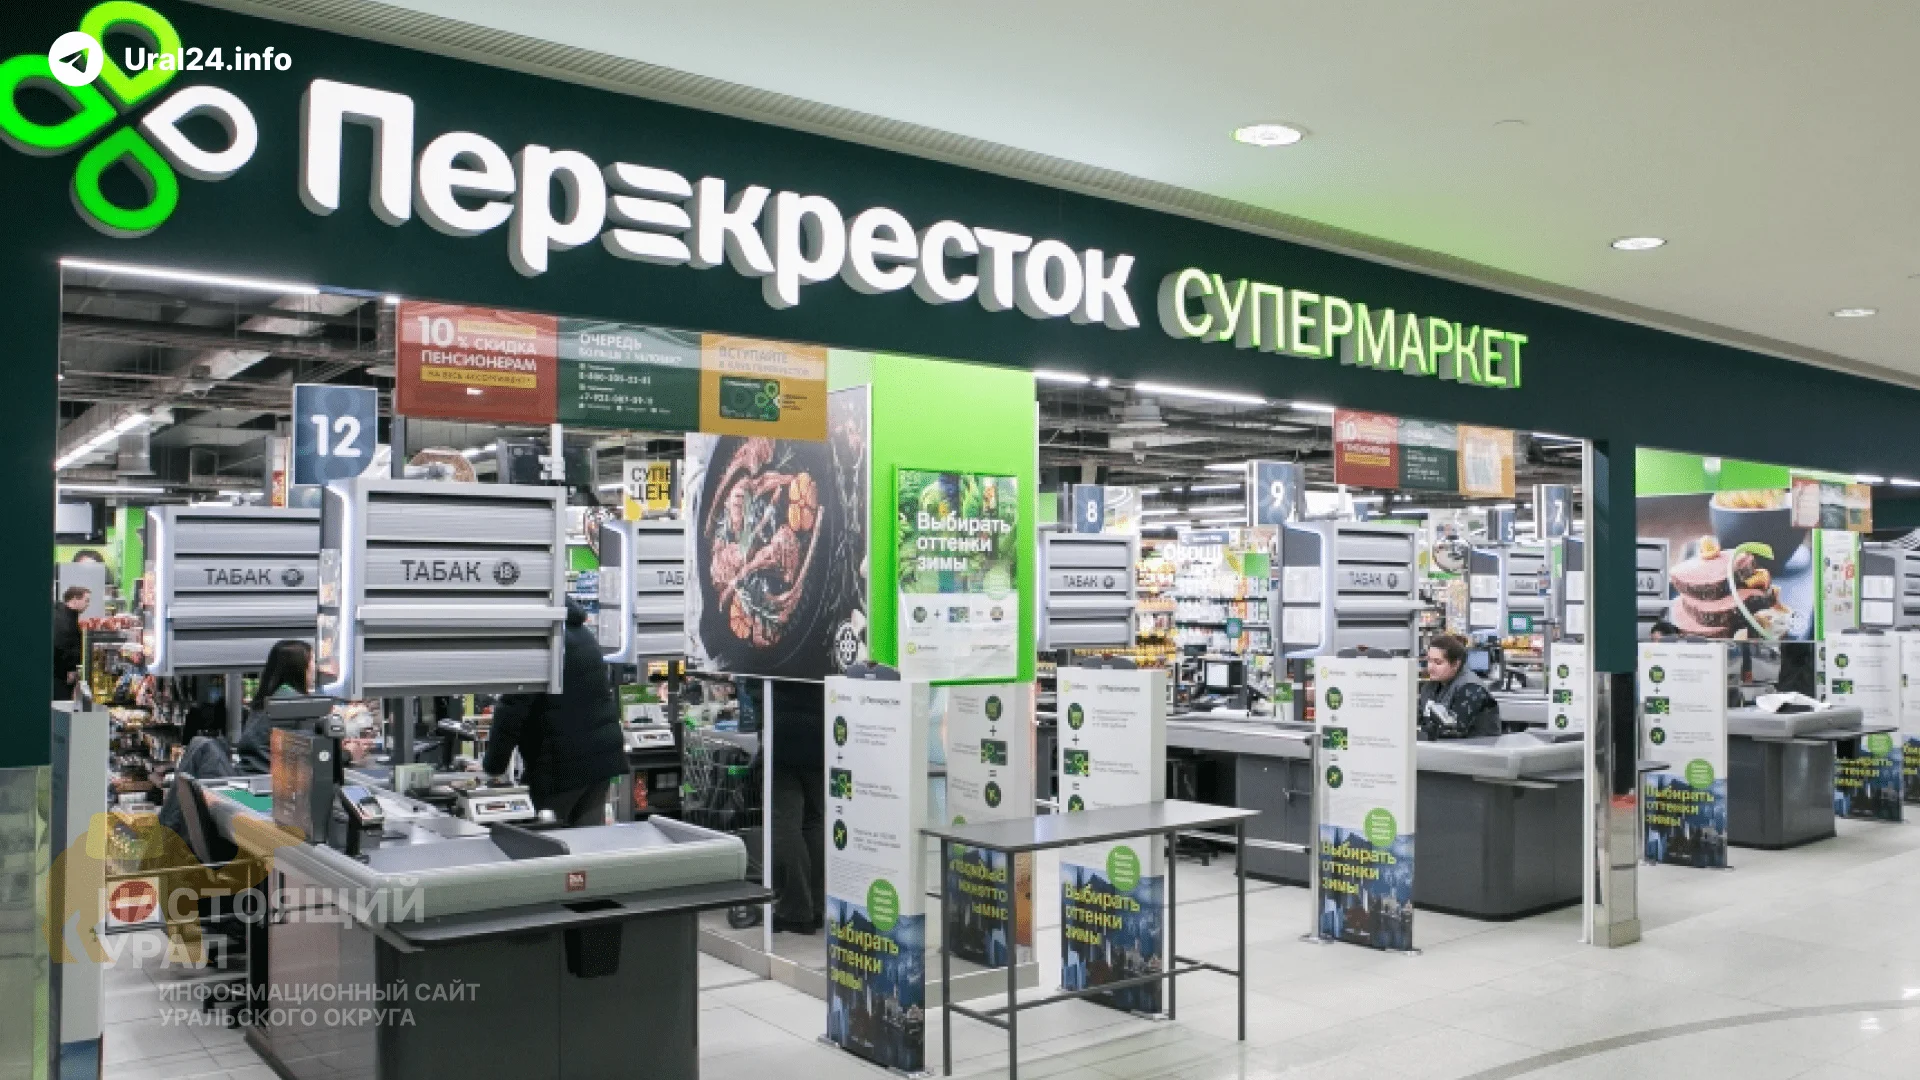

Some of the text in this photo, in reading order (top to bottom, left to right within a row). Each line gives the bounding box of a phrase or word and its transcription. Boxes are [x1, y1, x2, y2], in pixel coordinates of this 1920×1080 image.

[304, 79, 1140, 329] Перекресток
[418, 316, 454, 347] 10
[475, 338, 537, 355] СКИДКА
[1166, 267, 1528, 388] СУПЕРМАРКЕТ
[580, 333, 642, 350] ОЧЕРЕДЬ
[421, 349, 537, 371] ПЕНСИОНЕРАМ
[310, 414, 362, 458] 12
[1271, 481, 1284, 507] 9
[917, 509, 1012, 535] Выбирать
[1087, 501, 1098, 522] 8
[1554, 500, 1563, 522] 7
[917, 537, 993, 552] оттенки
[400, 559, 482, 582] ТАБАК
[917, 555, 968, 571] зимы
[203, 568, 272, 586] ТАБАК
[1322, 840, 1396, 865] Выбирать
[1322, 861, 1379, 879] оттенки
[1065, 881, 1140, 912] Выбирать
[1322, 877, 1359, 893] зимы
[1065, 906, 1122, 929] оттенки
